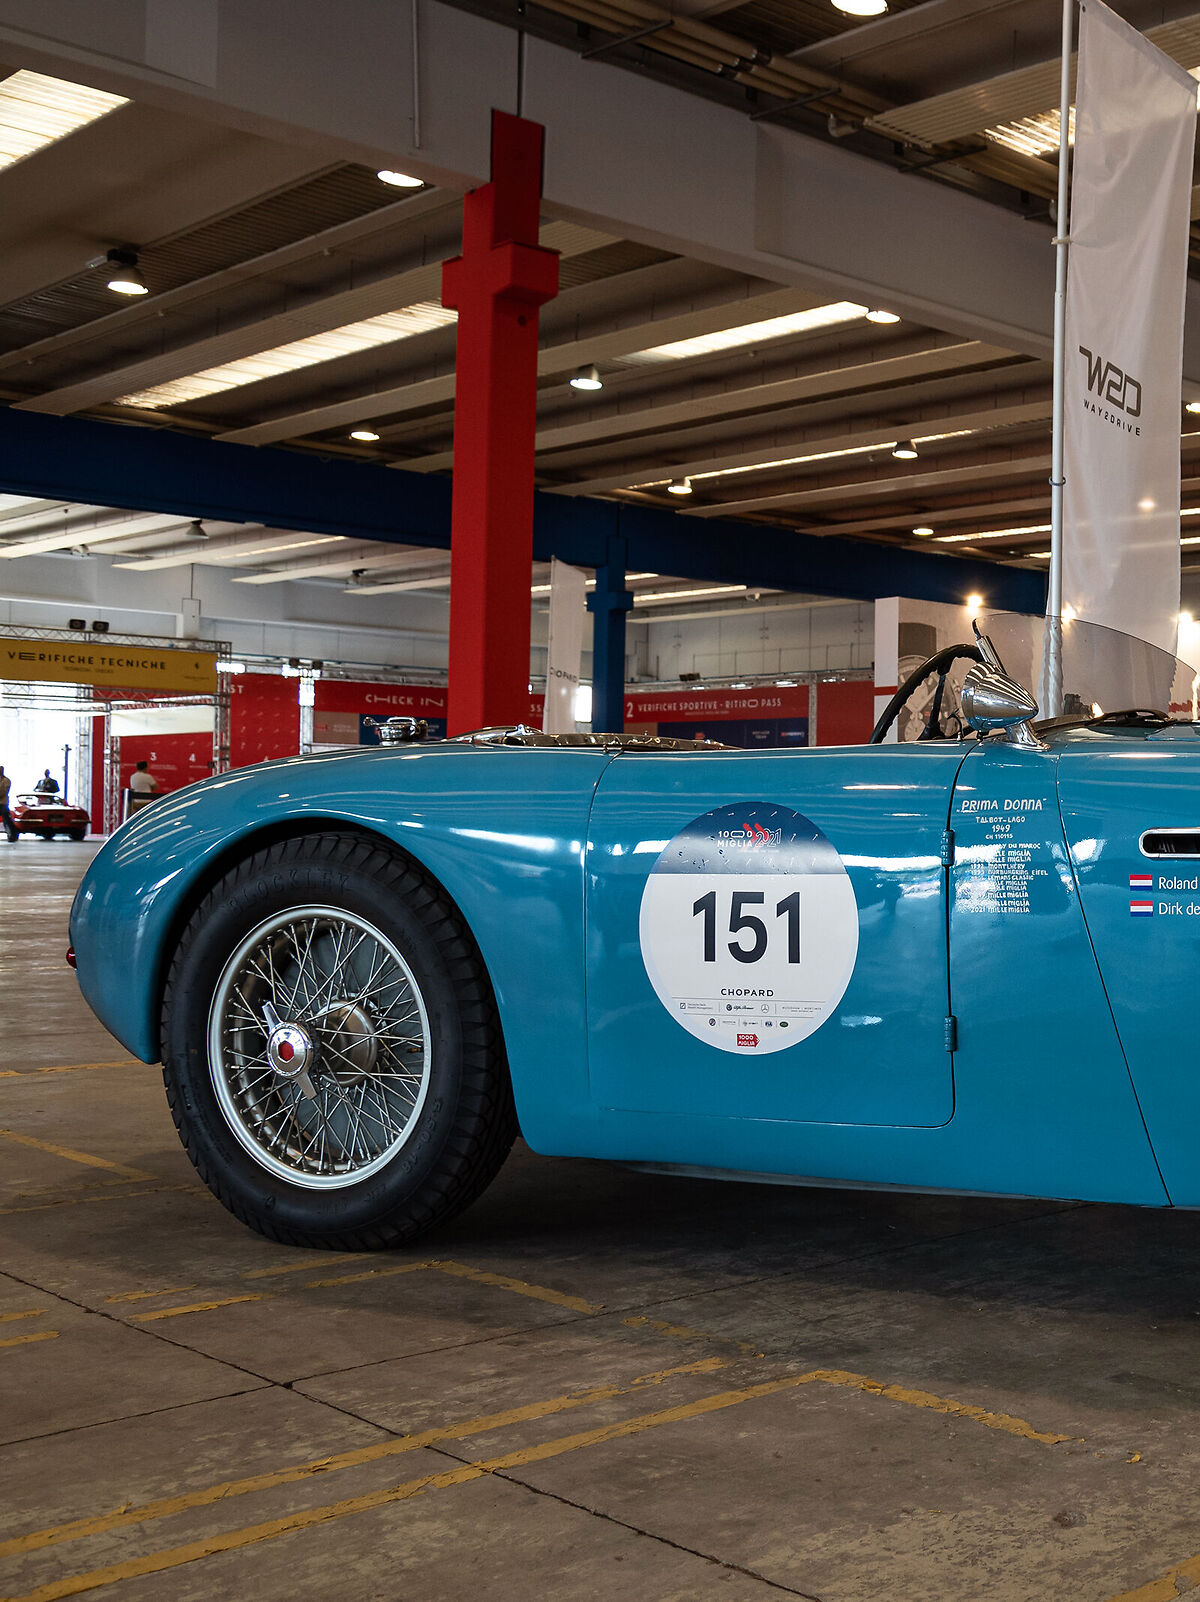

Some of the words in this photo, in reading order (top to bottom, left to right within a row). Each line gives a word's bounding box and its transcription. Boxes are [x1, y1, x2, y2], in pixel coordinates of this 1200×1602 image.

[1079, 345, 1142, 418] W2D
[1083, 399, 1141, 437] WAY2DRIVE
[7, 651, 94, 665] VERIFICHE
[100, 657, 166, 670] TECNICHE
[365, 694, 414, 705] CHECK
[626, 702, 634, 718] 2
[637, 703, 677, 713] VERIFICHE
[679, 701, 717, 711] SPORTIVE
[725, 699, 759, 709] RITIRO
[760, 698, 782, 707] PASS
[992, 824, 1011, 832] 1949
[717, 839, 753, 848] MIGLIA
[1158, 876, 1198, 890] Roland
[1158, 902, 1183, 915] Dirk
[1186, 902, 1200, 915] de
[693, 891, 801, 964] 151
[720, 988, 774, 997] CHOPARD
